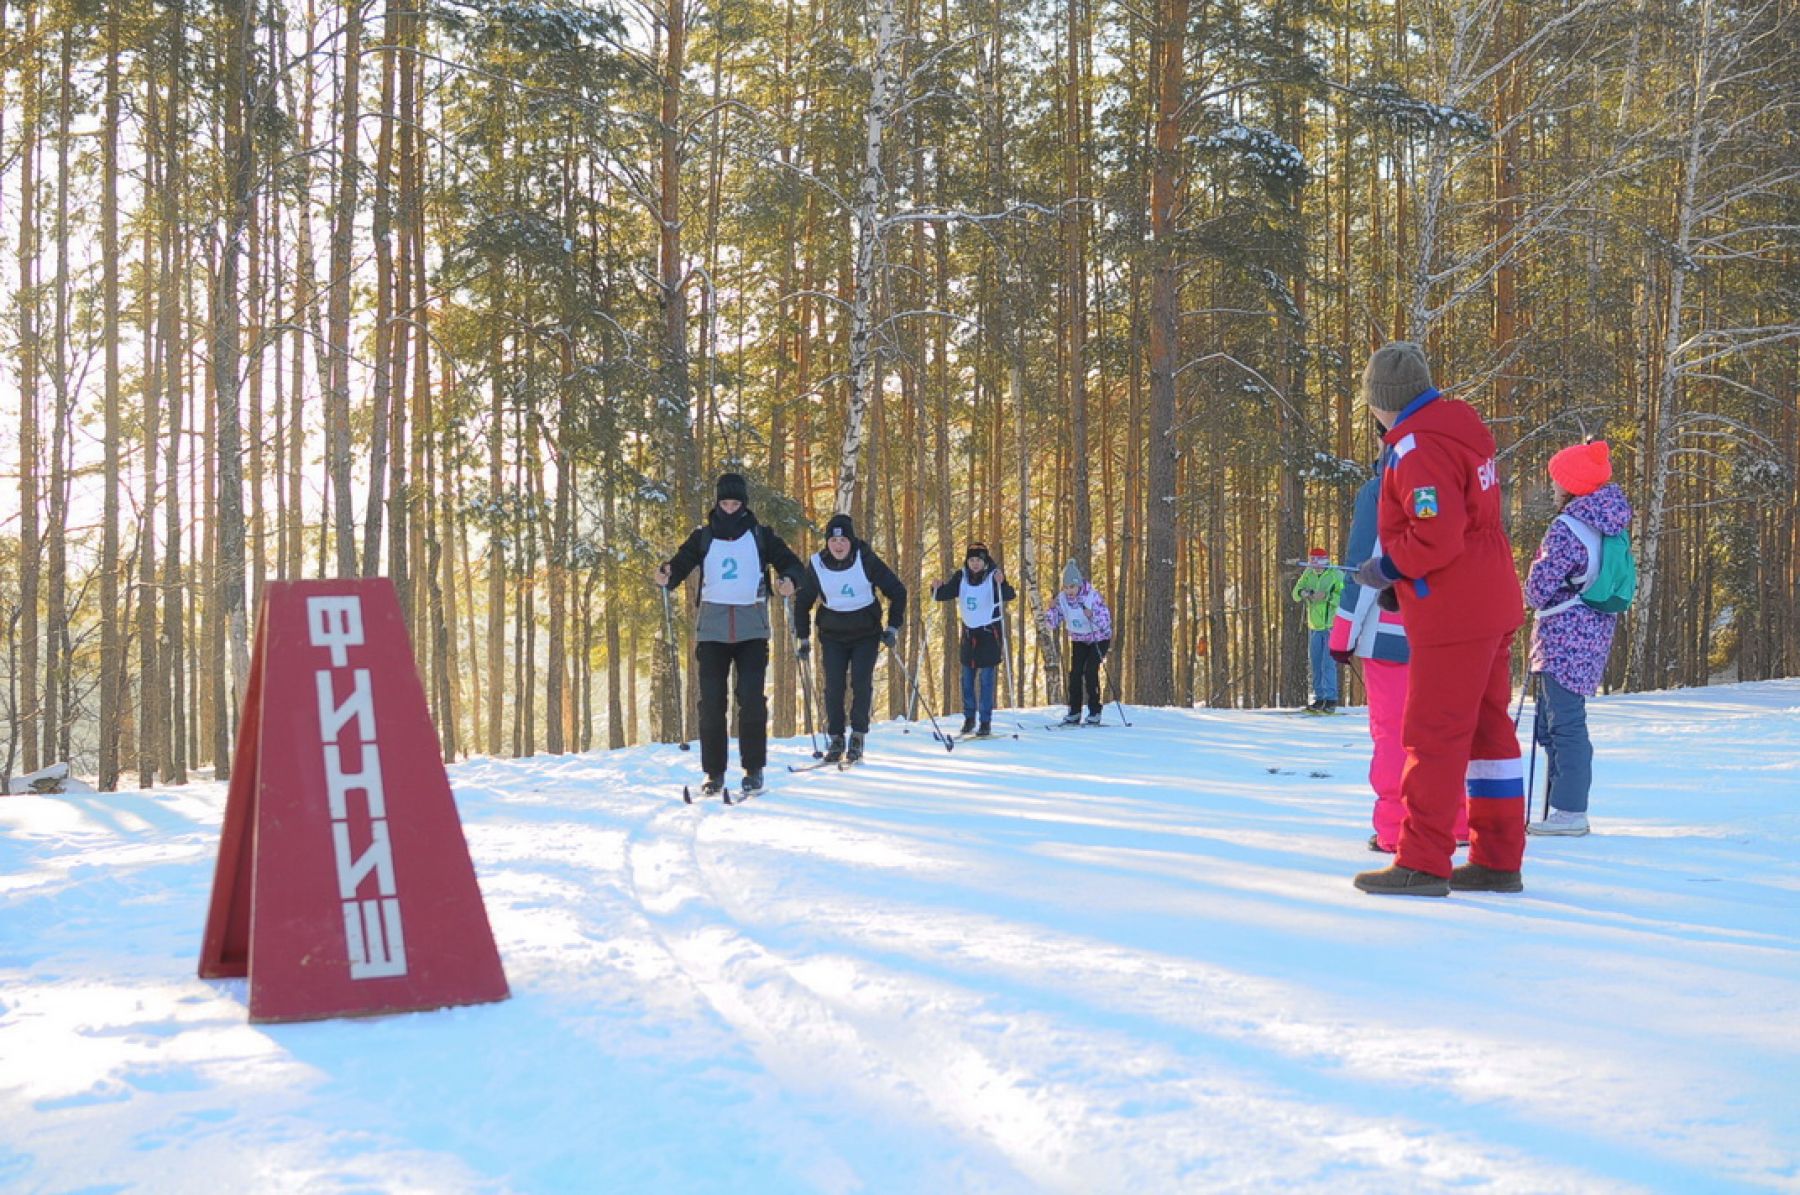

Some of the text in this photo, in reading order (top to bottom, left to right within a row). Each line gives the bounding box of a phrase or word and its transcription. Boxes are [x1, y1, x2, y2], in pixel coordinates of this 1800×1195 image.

[721, 557, 738, 580] 2
[841, 583, 855, 598] 4
[966, 596, 977, 611] 5
[306, 595, 408, 981] ФИНИШ
